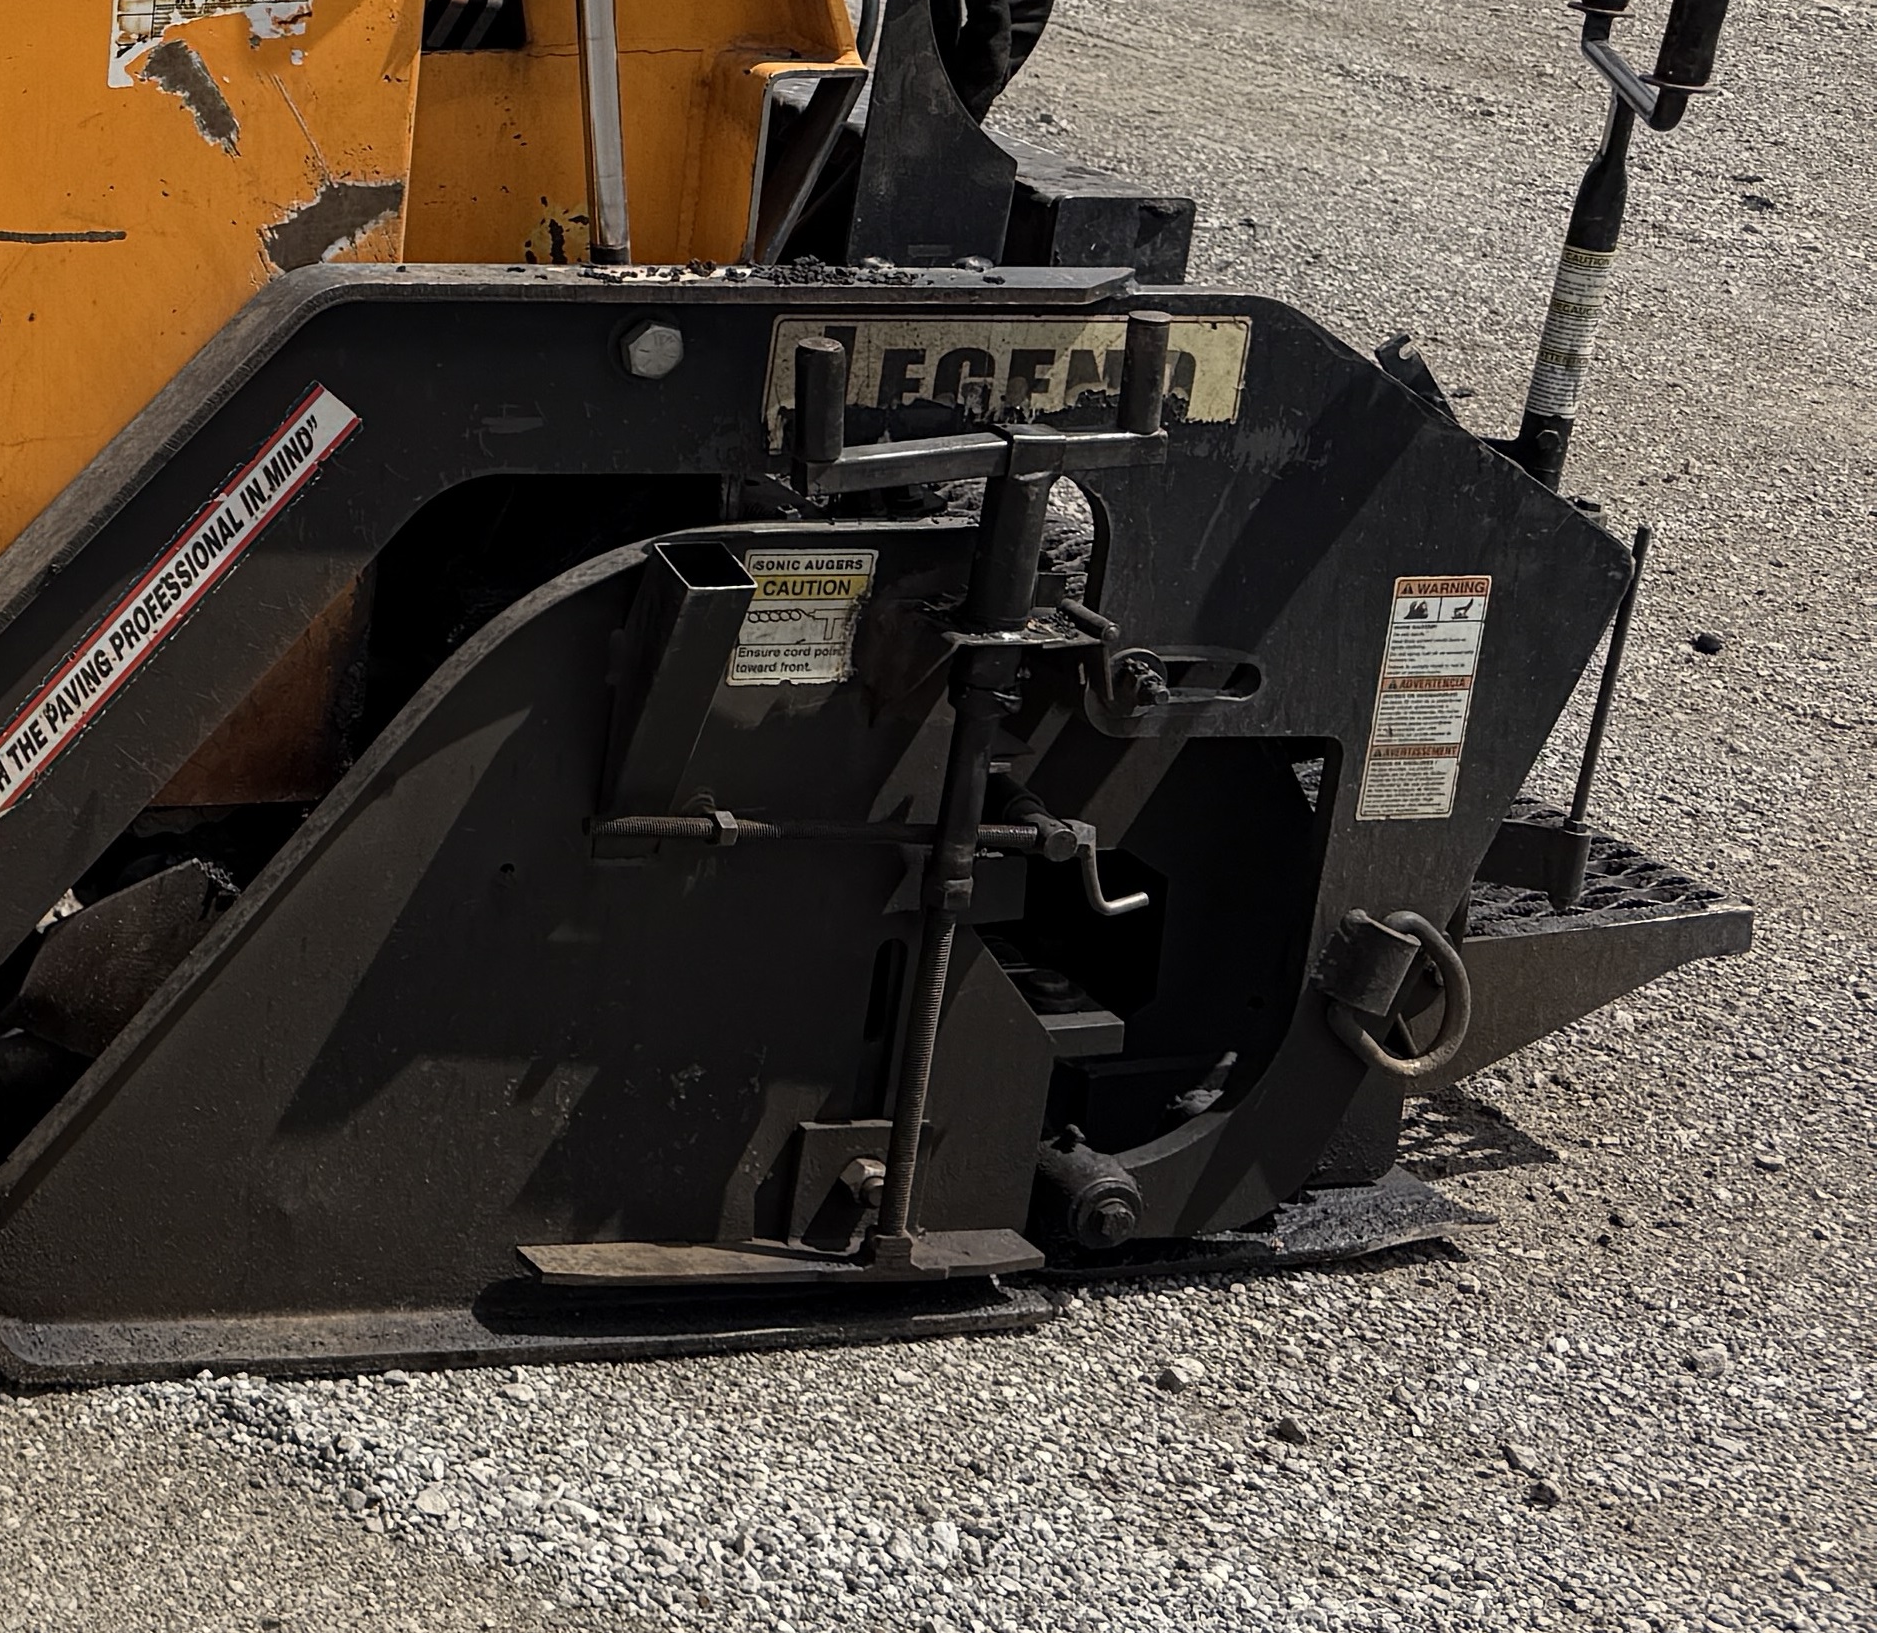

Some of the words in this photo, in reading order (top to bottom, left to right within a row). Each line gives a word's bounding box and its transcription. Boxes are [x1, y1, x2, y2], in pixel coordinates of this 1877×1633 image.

[808, 325, 1197, 417] EGEND
[763, 580, 852, 596] CAUTION
[1417, 581, 1486, 596] WARNING
[7, 719, 48, 772] THE
[44, 649, 114, 734] PAVING
[109, 507, 245, 661] PROFESSIONAL
[239, 477, 269, 518] IN
